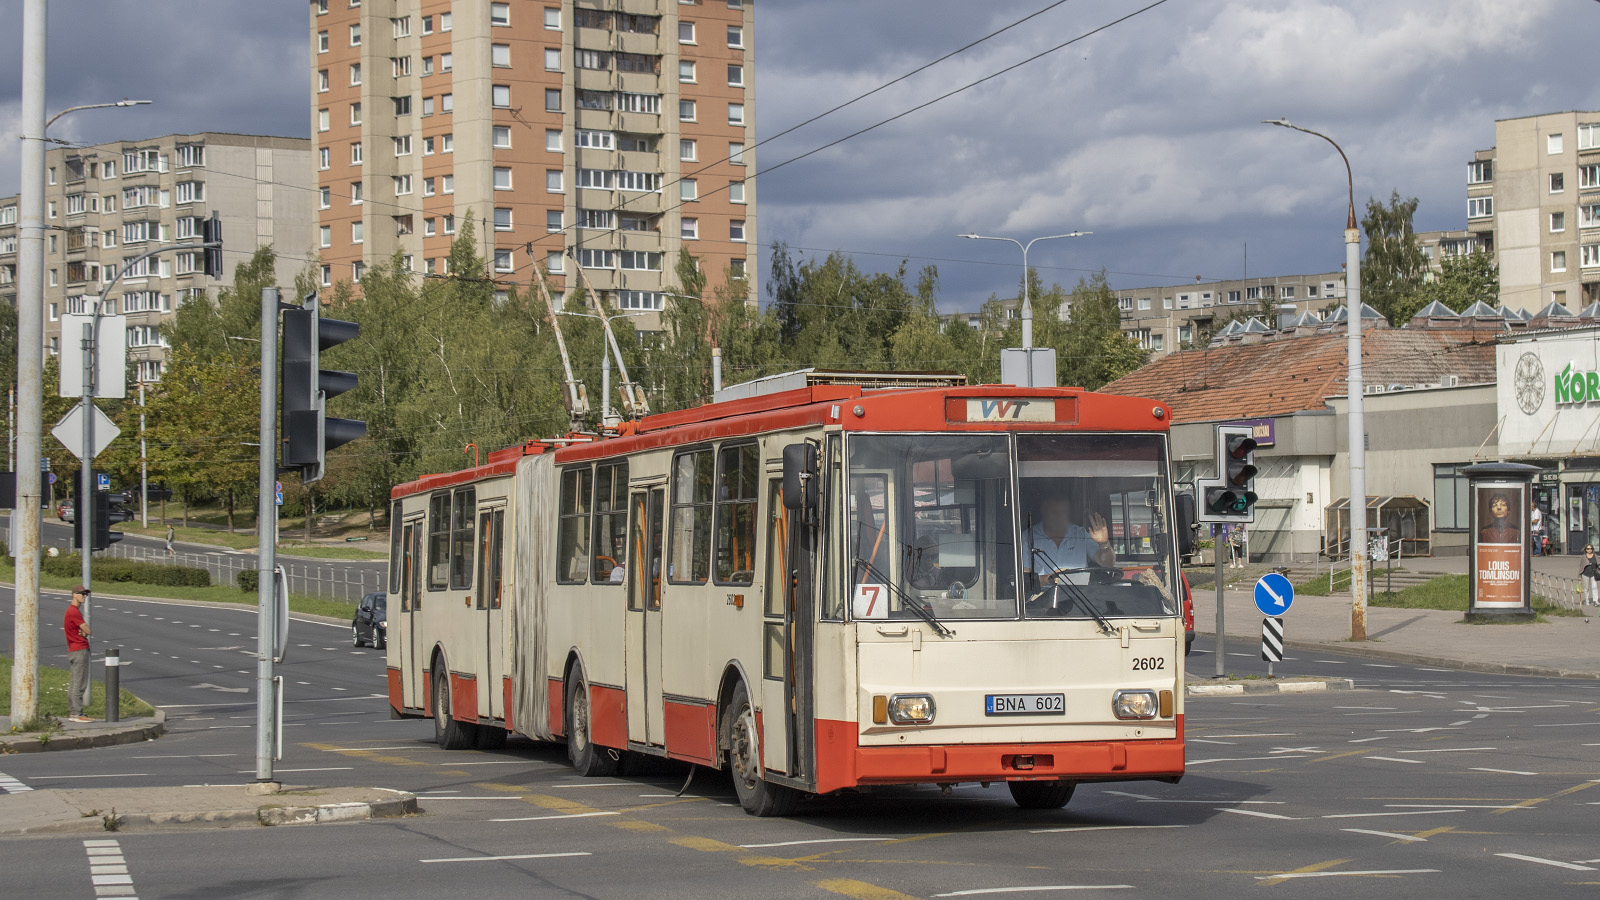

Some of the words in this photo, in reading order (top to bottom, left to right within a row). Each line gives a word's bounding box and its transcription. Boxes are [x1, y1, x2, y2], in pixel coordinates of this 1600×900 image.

[981, 400, 1030, 418] VVT
[1488, 561, 1510, 571] LOUIS
[1479, 570, 1520, 580] TOMLINSON
[861, 586, 880, 617] 7
[1132, 656, 1165, 671] 2602
[995, 697, 1026, 711] BNA
[1036, 696, 1062, 710] 602
